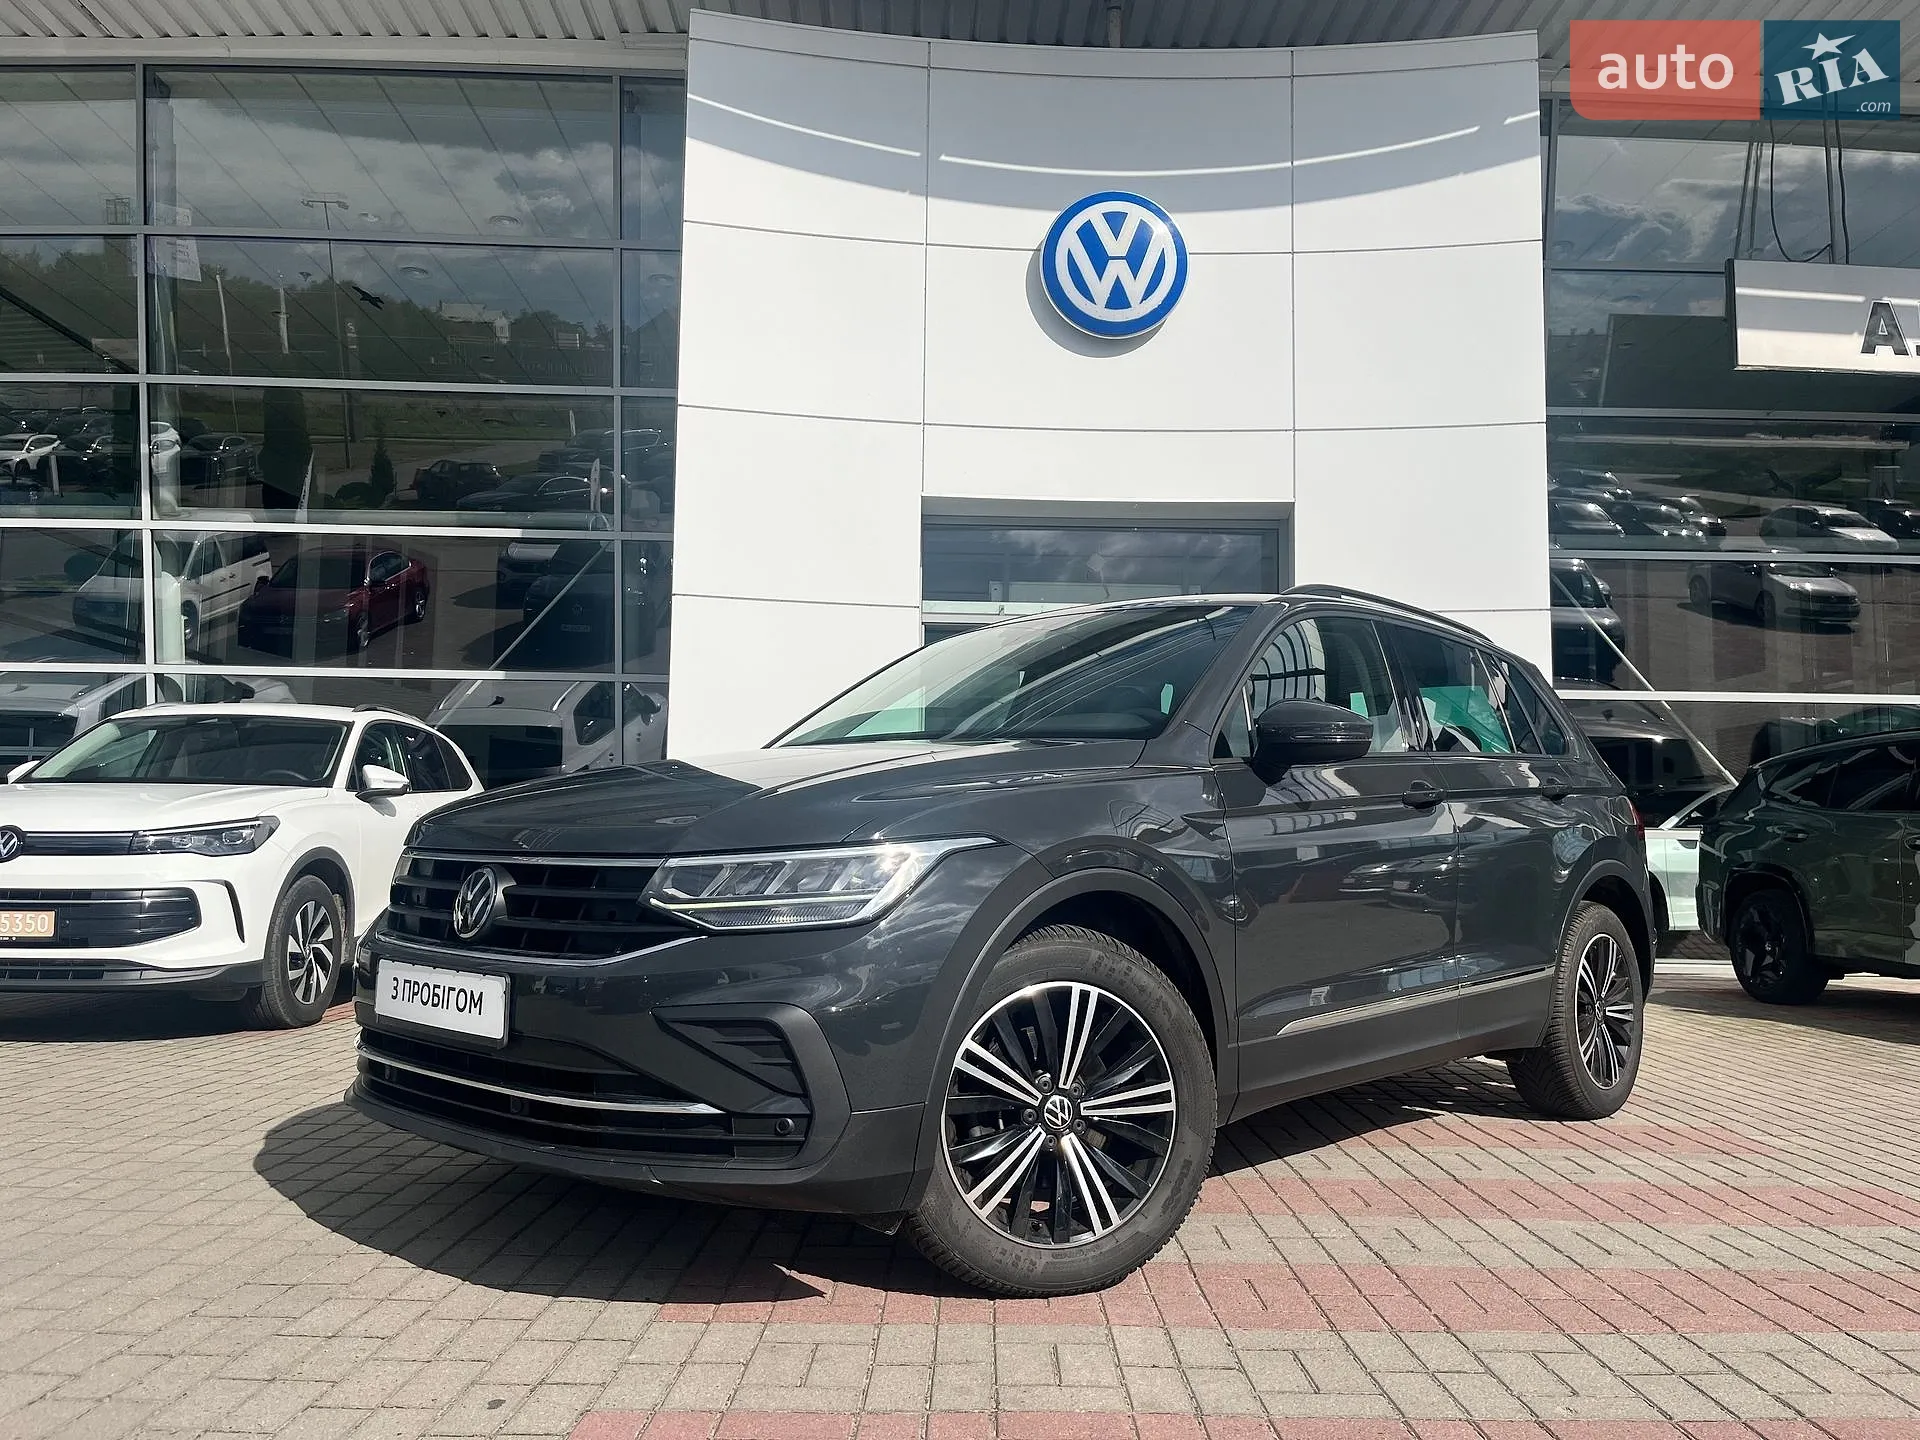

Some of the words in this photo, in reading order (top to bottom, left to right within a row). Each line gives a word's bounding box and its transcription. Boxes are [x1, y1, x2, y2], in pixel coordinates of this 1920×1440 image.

[1860, 301, 1920, 356] A
[0, 914, 49, 933] 5350
[391, 977, 399, 1000] З
[402, 979, 484, 1016] ПРОБІГОМ
